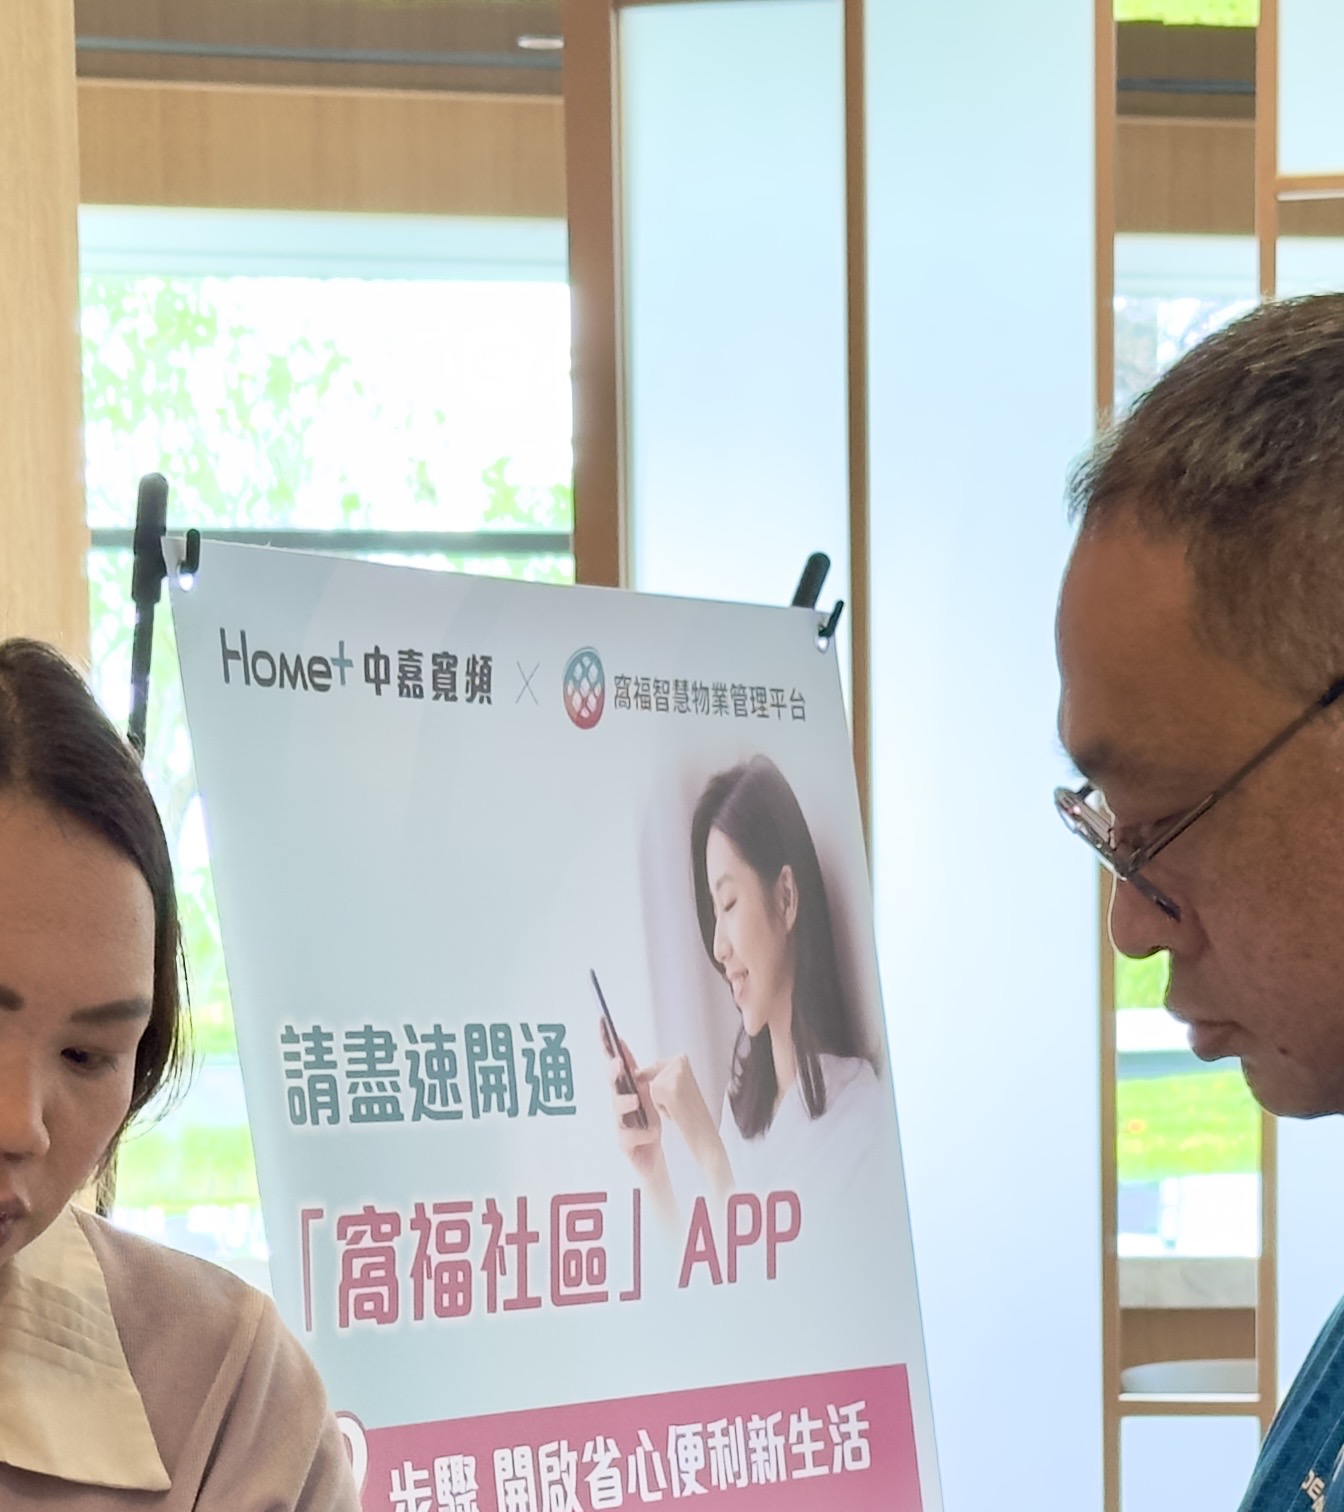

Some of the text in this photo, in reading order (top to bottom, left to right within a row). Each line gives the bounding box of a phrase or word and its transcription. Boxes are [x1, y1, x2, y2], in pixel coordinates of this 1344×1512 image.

[363, 644, 493, 705] 中嘉寬頻
[613, 673, 807, 722] 窩福智慧物業管理平台
[279, 1022, 577, 1128] 請盡速開通
[300, 1187, 802, 1334] 「窩福社區」 APP
